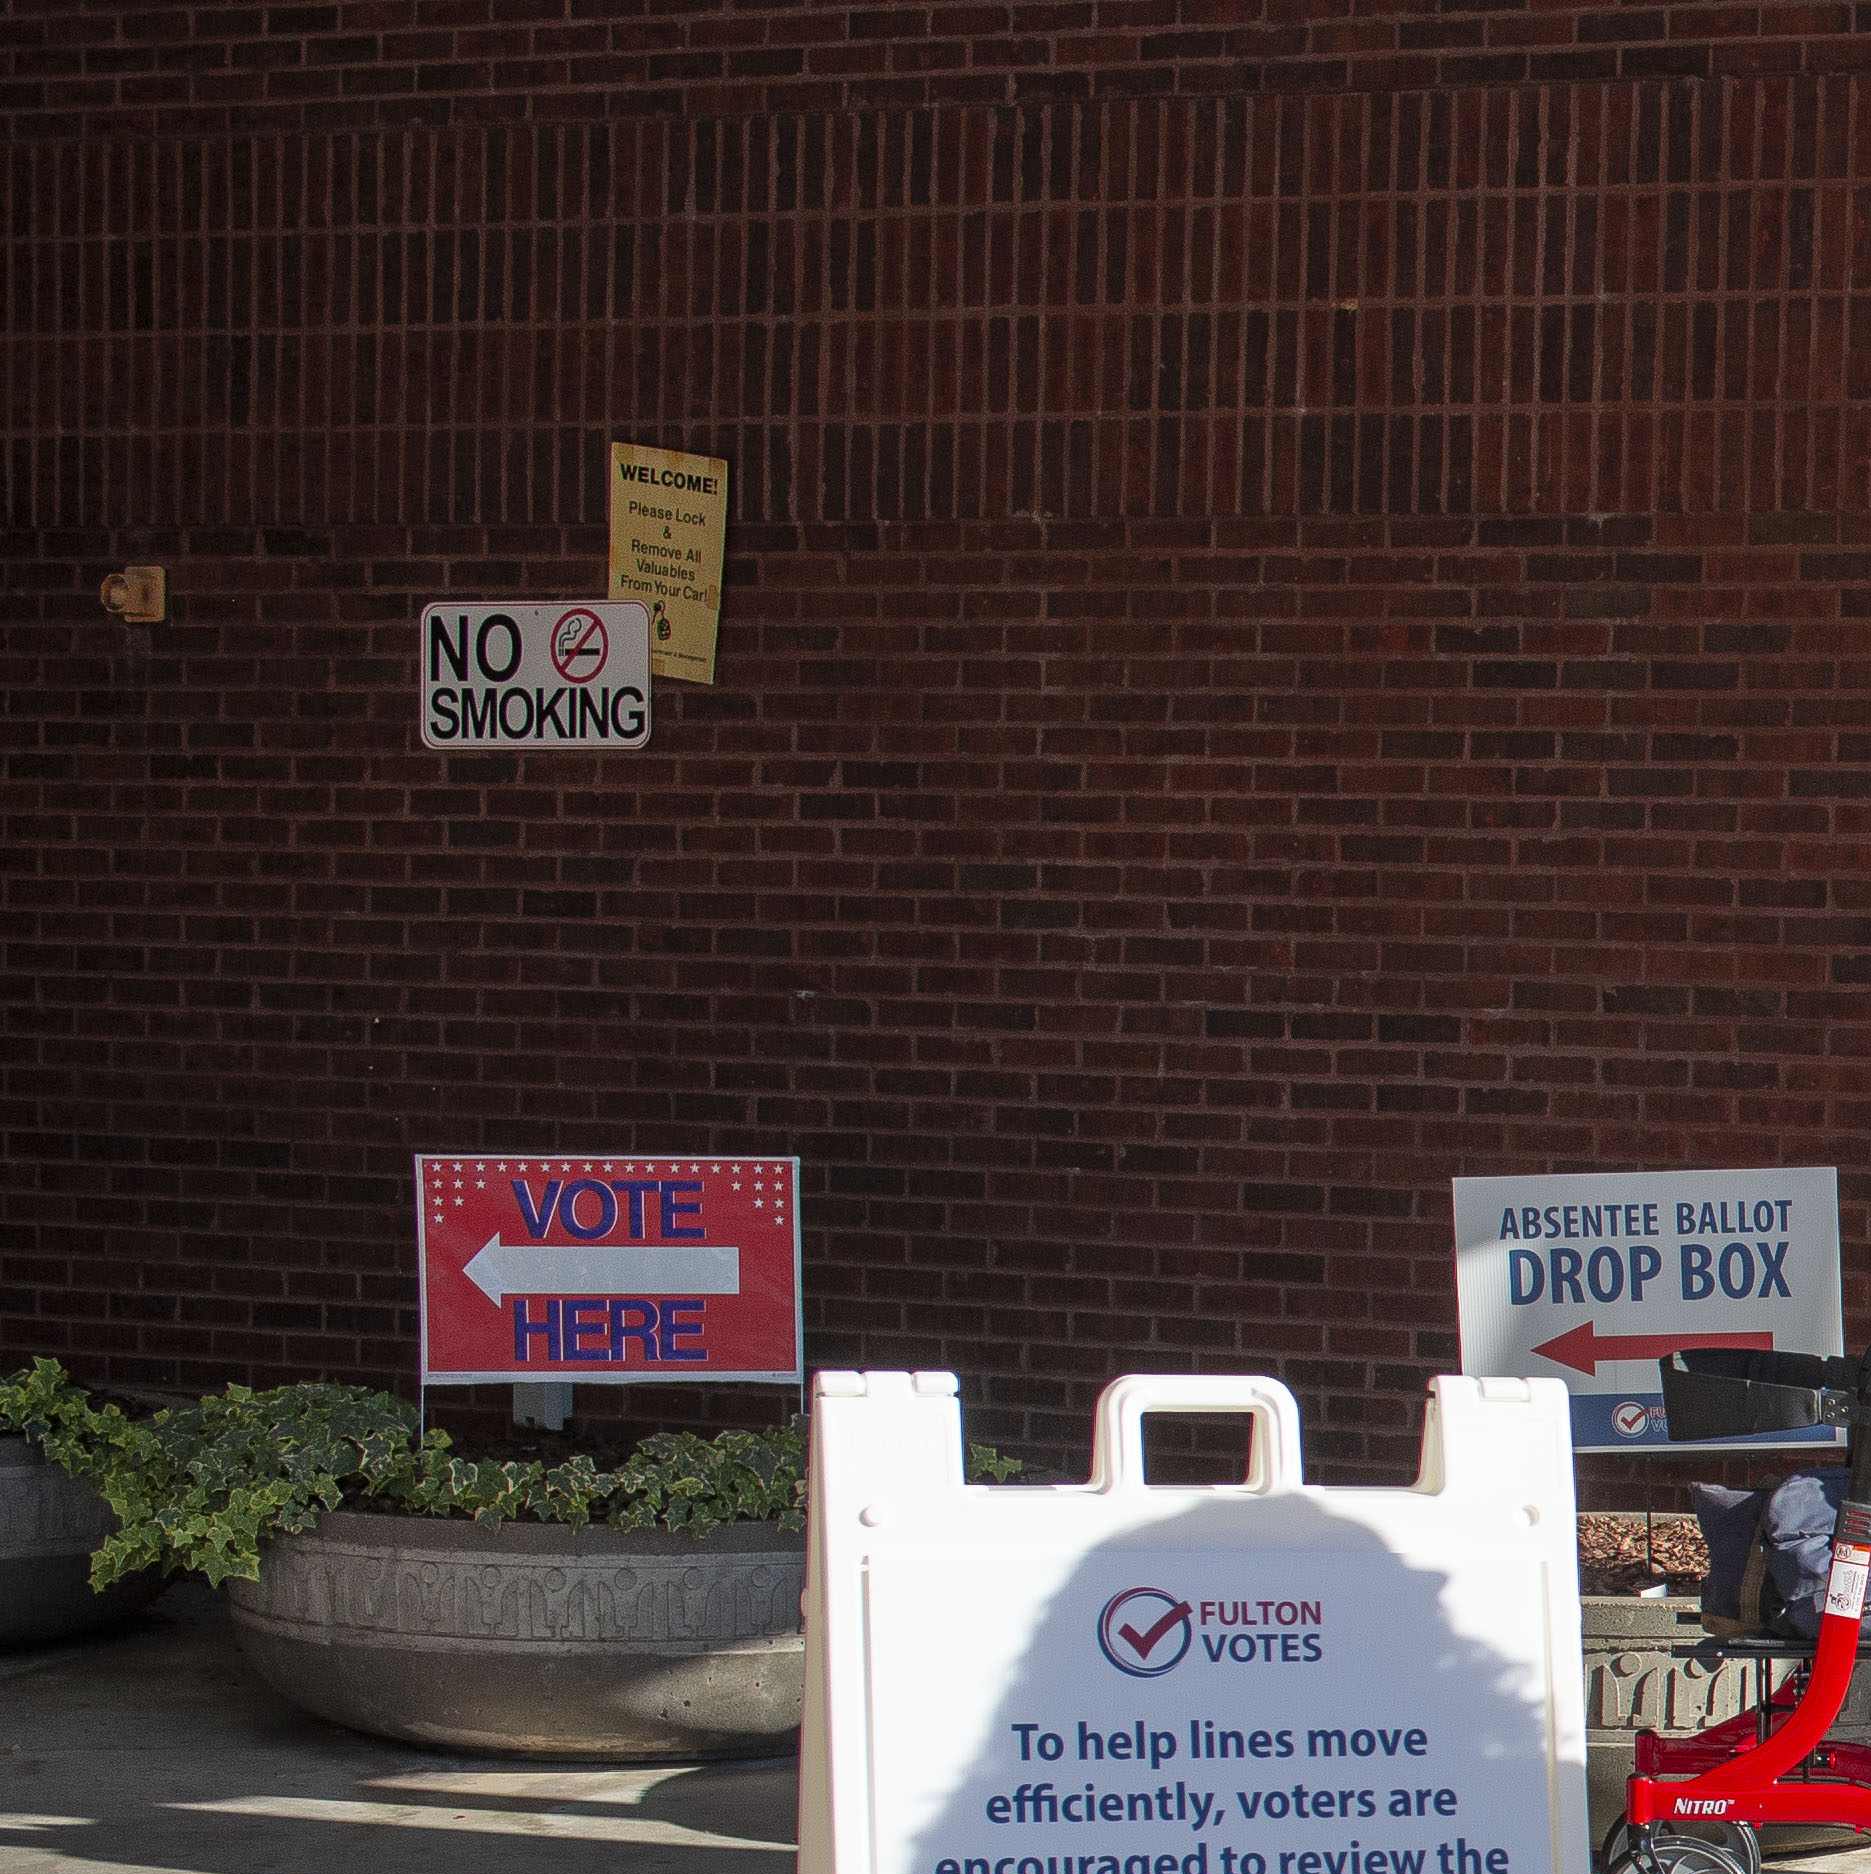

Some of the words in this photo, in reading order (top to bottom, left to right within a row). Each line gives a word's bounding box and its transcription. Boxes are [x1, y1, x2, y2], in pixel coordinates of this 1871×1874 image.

[620, 463, 718, 495] WELCOME!
[629, 500, 672, 521] Please
[676, 507, 706, 527] Lock
[663, 526, 672, 539] &
[631, 539, 682, 560] Remove
[685, 548, 702, 563] All
[620, 574, 652, 593] From
[655, 580, 682, 599] Your
[636, 558, 696, 581] Valuables
[430, 613, 523, 683] NO
[429, 686, 646, 739] SMOKING
[511, 1179, 707, 1239] VOTE
[1500, 1203, 1660, 1240] ABSENTEE
[1677, 1200, 1792, 1235] BALLOT
[1508, 1245, 1662, 1306] DROP
[1680, 1241, 1792, 1300] BOX
[513, 1299, 709, 1362] HERE
[1200, 1600, 1322, 1626] FULTON
[1202, 1633, 1323, 1663] VOTES
[1011, 1723, 1064, 1761] To
[1077, 1720, 1177, 1770] help
[1190, 1719, 1294, 1760] lines
[1307, 1728, 1428, 1758] move
[986, 1781, 1225, 1831] efficiently,
[1236, 1784, 1376, 1819] voters
[1388, 1788, 1458, 1818] are
